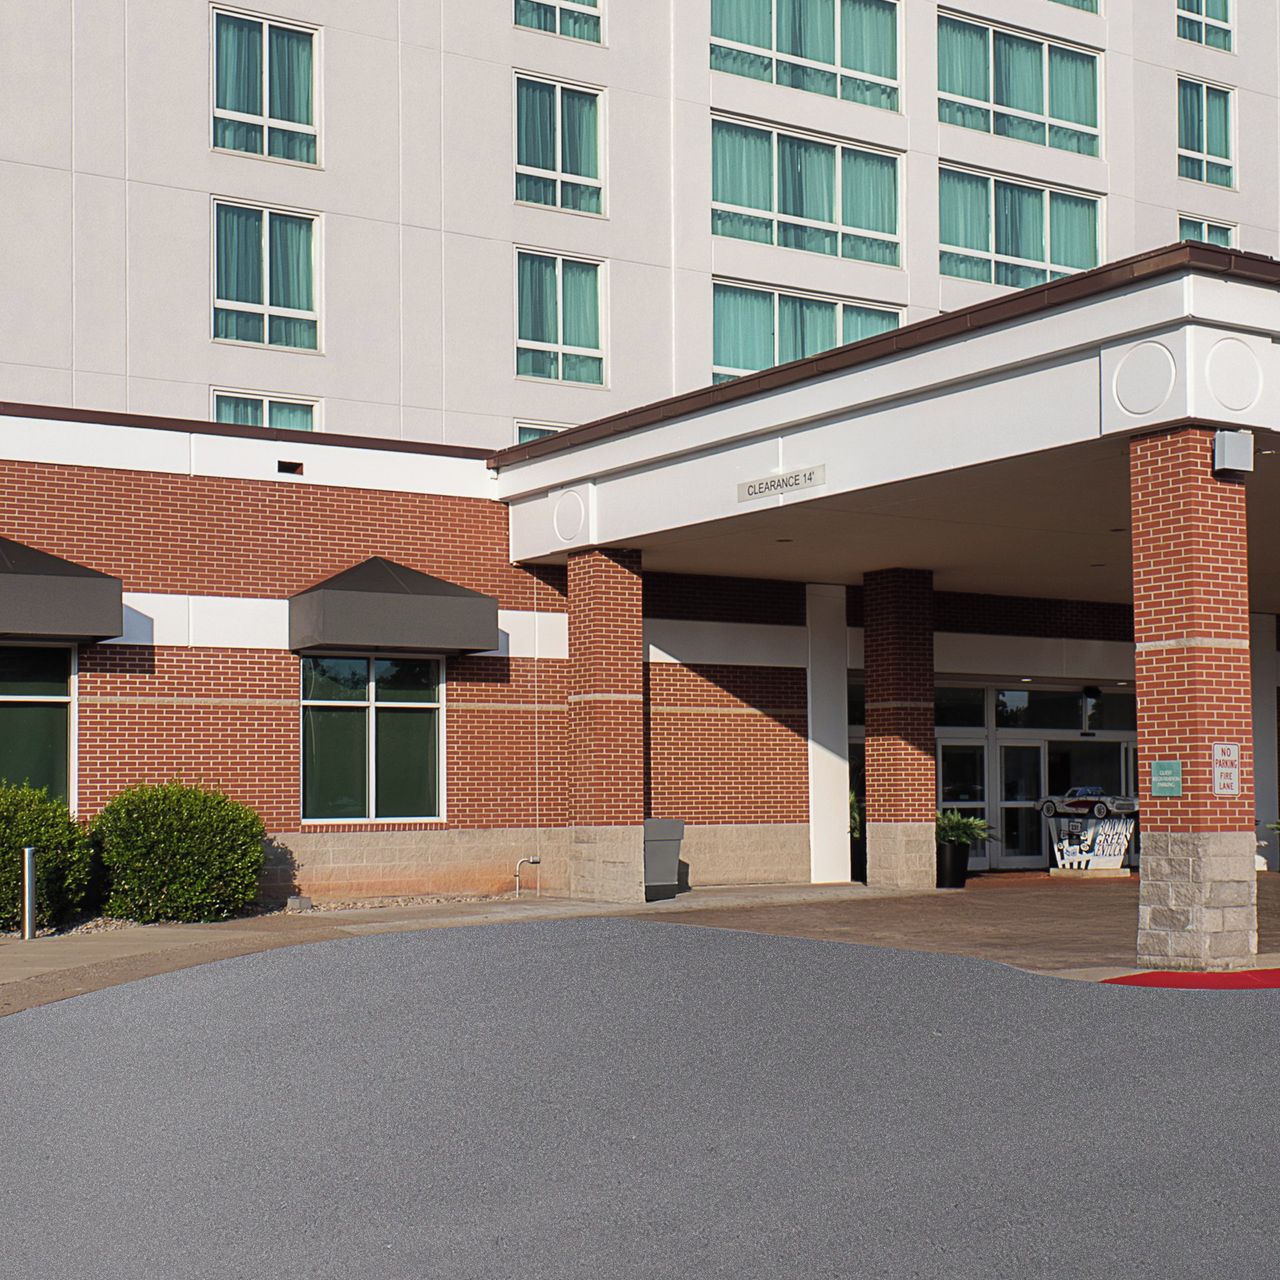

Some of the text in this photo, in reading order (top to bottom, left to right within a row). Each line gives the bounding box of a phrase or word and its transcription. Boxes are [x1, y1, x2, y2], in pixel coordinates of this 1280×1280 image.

[747, 471, 815, 496] CLEARANCE 14'
[1221, 747, 1231, 757] NO
[1215, 759, 1237, 769] PARKING
[1220, 772, 1233, 780] FIRE
[1219, 782, 1234, 791] LANE
[1096, 832, 1130, 844] GREEN
